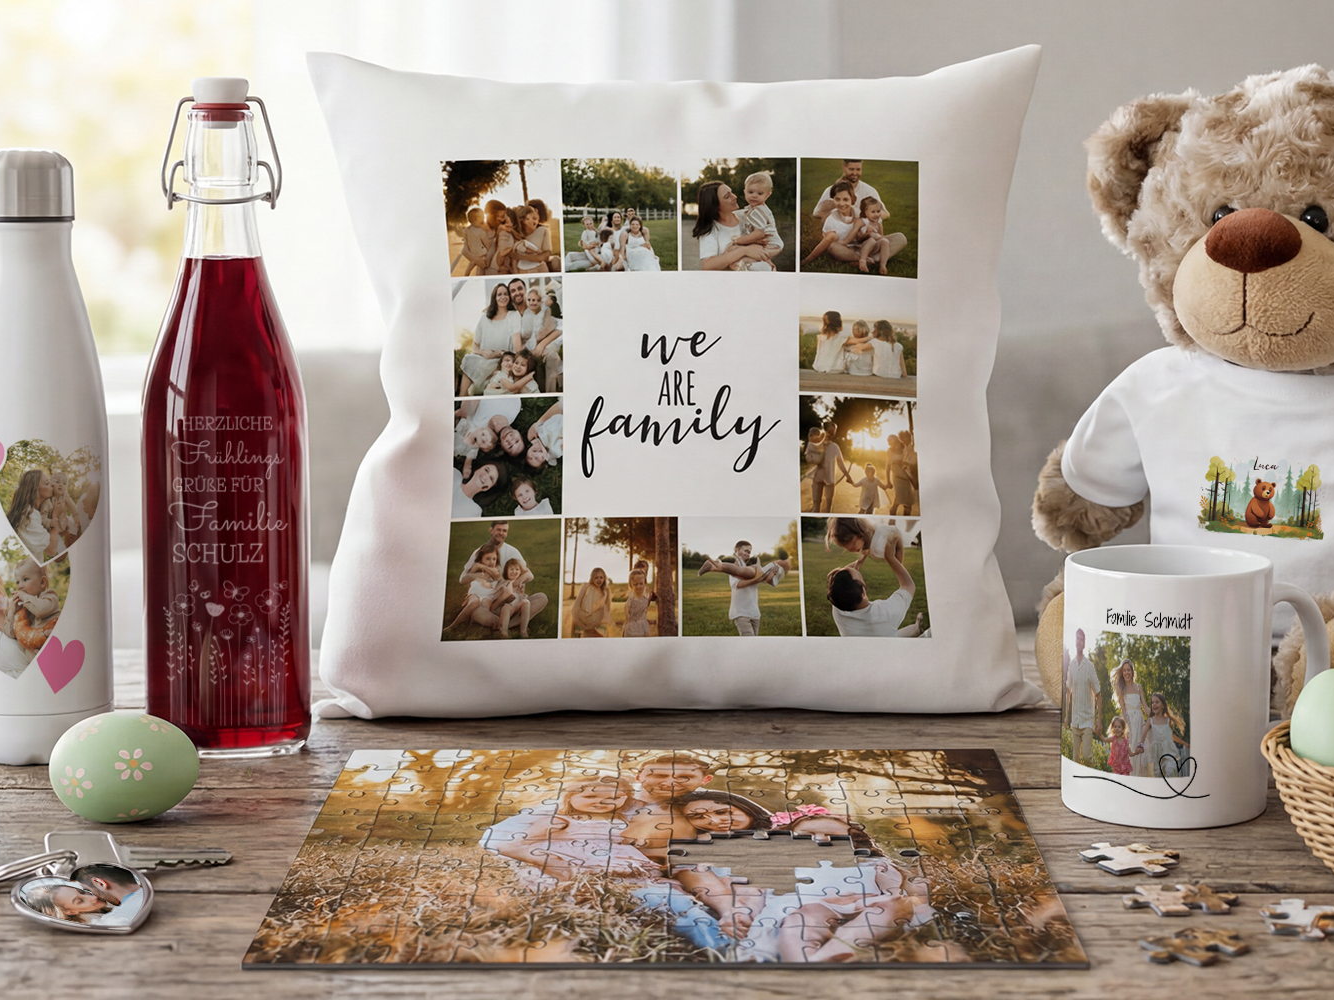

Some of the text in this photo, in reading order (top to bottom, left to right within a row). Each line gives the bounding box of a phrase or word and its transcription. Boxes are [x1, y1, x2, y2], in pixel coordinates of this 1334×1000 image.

[640, 331, 722, 365] we
[657, 369, 696, 406] ARE
[182, 416, 273, 431] HERZLICHE
[581, 384, 781, 479] family
[171, 440, 285, 480] Frühlings
[230, 475, 265, 493] FÜR
[168, 500, 288, 531] Familie
[172, 542, 264, 565] SCHULZ
[1106, 608, 1194, 630] Familie Schmidt
